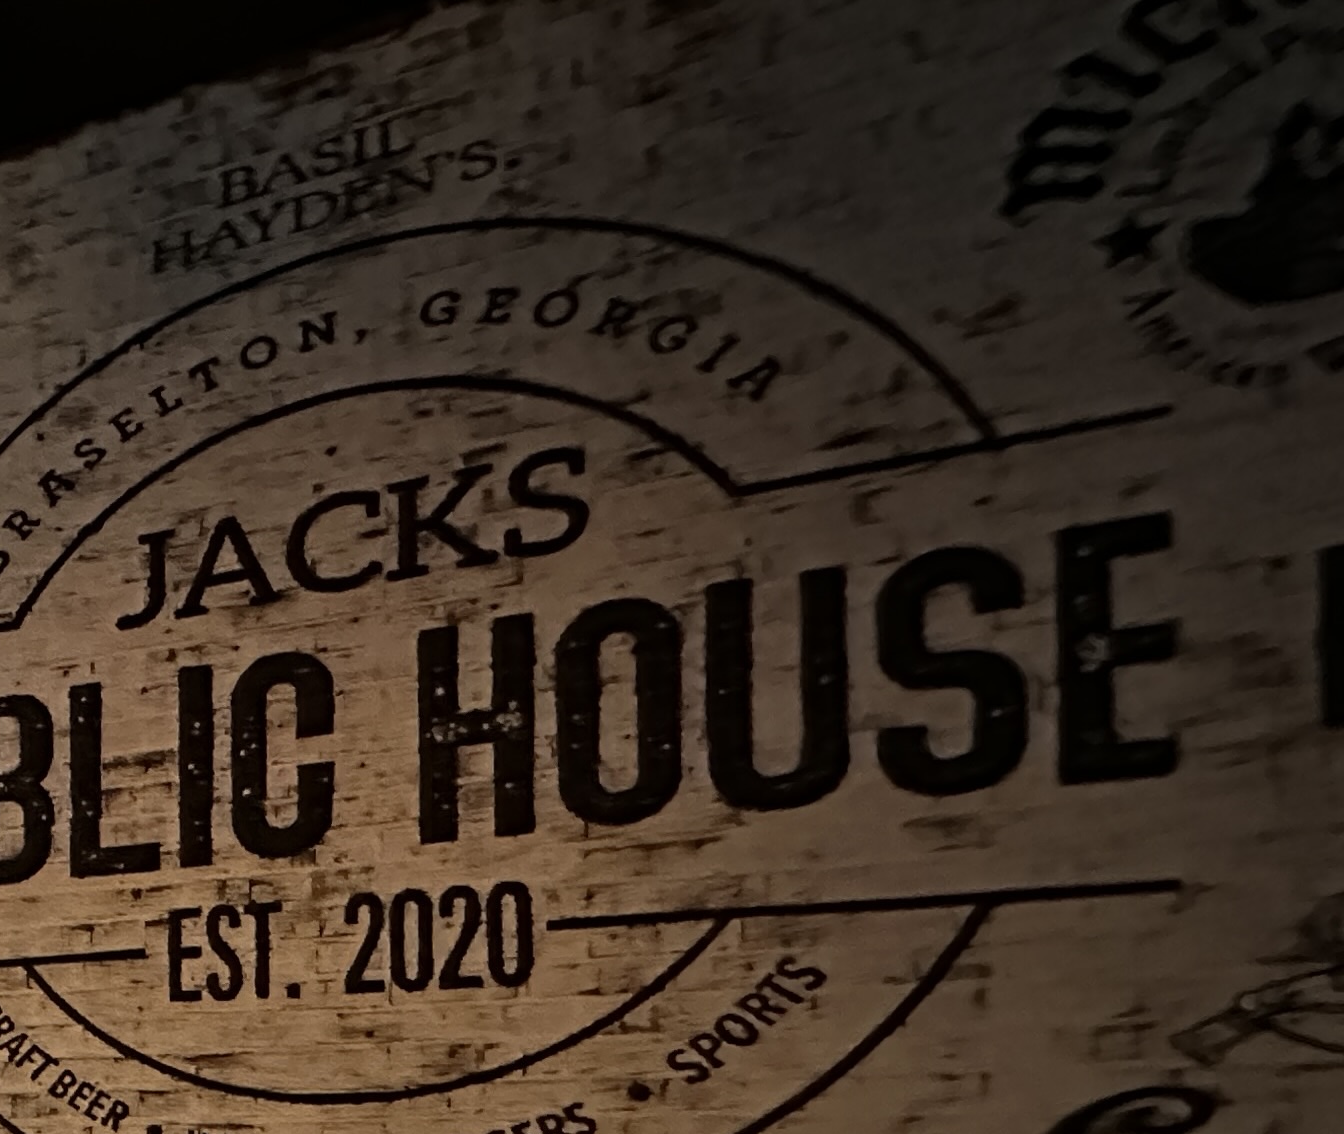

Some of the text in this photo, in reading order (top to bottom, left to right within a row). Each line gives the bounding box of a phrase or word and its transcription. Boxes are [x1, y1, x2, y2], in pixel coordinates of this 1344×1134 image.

[217, 121, 415, 209] BASIL
[420, 283, 784, 400] GEORGIA
[115, 447, 591, 632] JACKS
[415, 512, 1176, 845] HOUSE
[167, 879, 535, 1002] EST. 2020
[51, 1068, 131, 1134] BEER
[666, 955, 828, 1085] SPORTS
